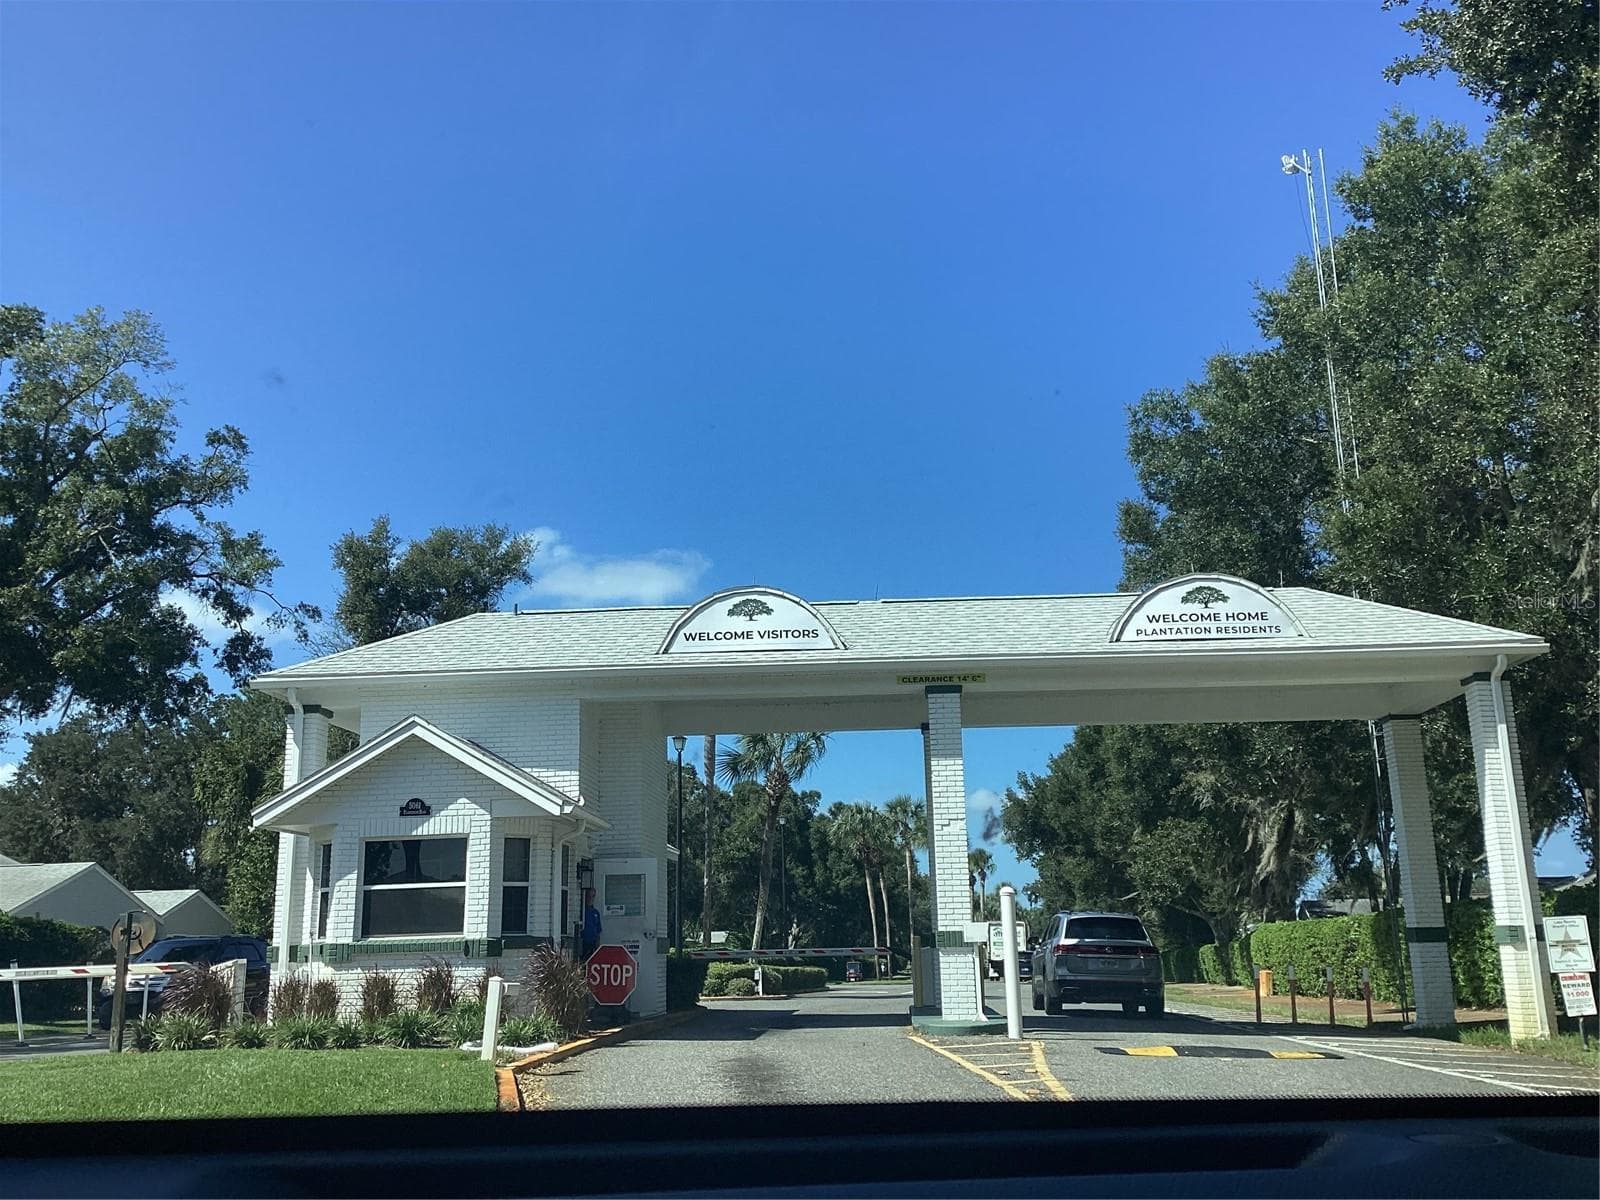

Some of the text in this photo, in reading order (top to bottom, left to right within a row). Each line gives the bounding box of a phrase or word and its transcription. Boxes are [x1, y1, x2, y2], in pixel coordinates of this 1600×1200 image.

[1146, 611, 1269, 624] WELCOME HOME
[683, 629, 819, 642] WELCOME VISITORS
[1136, 625, 1282, 637] PLANTATION RESIDENTS
[901, 675, 954, 684] CLEARANCE
[590, 964, 633, 986] STOP
